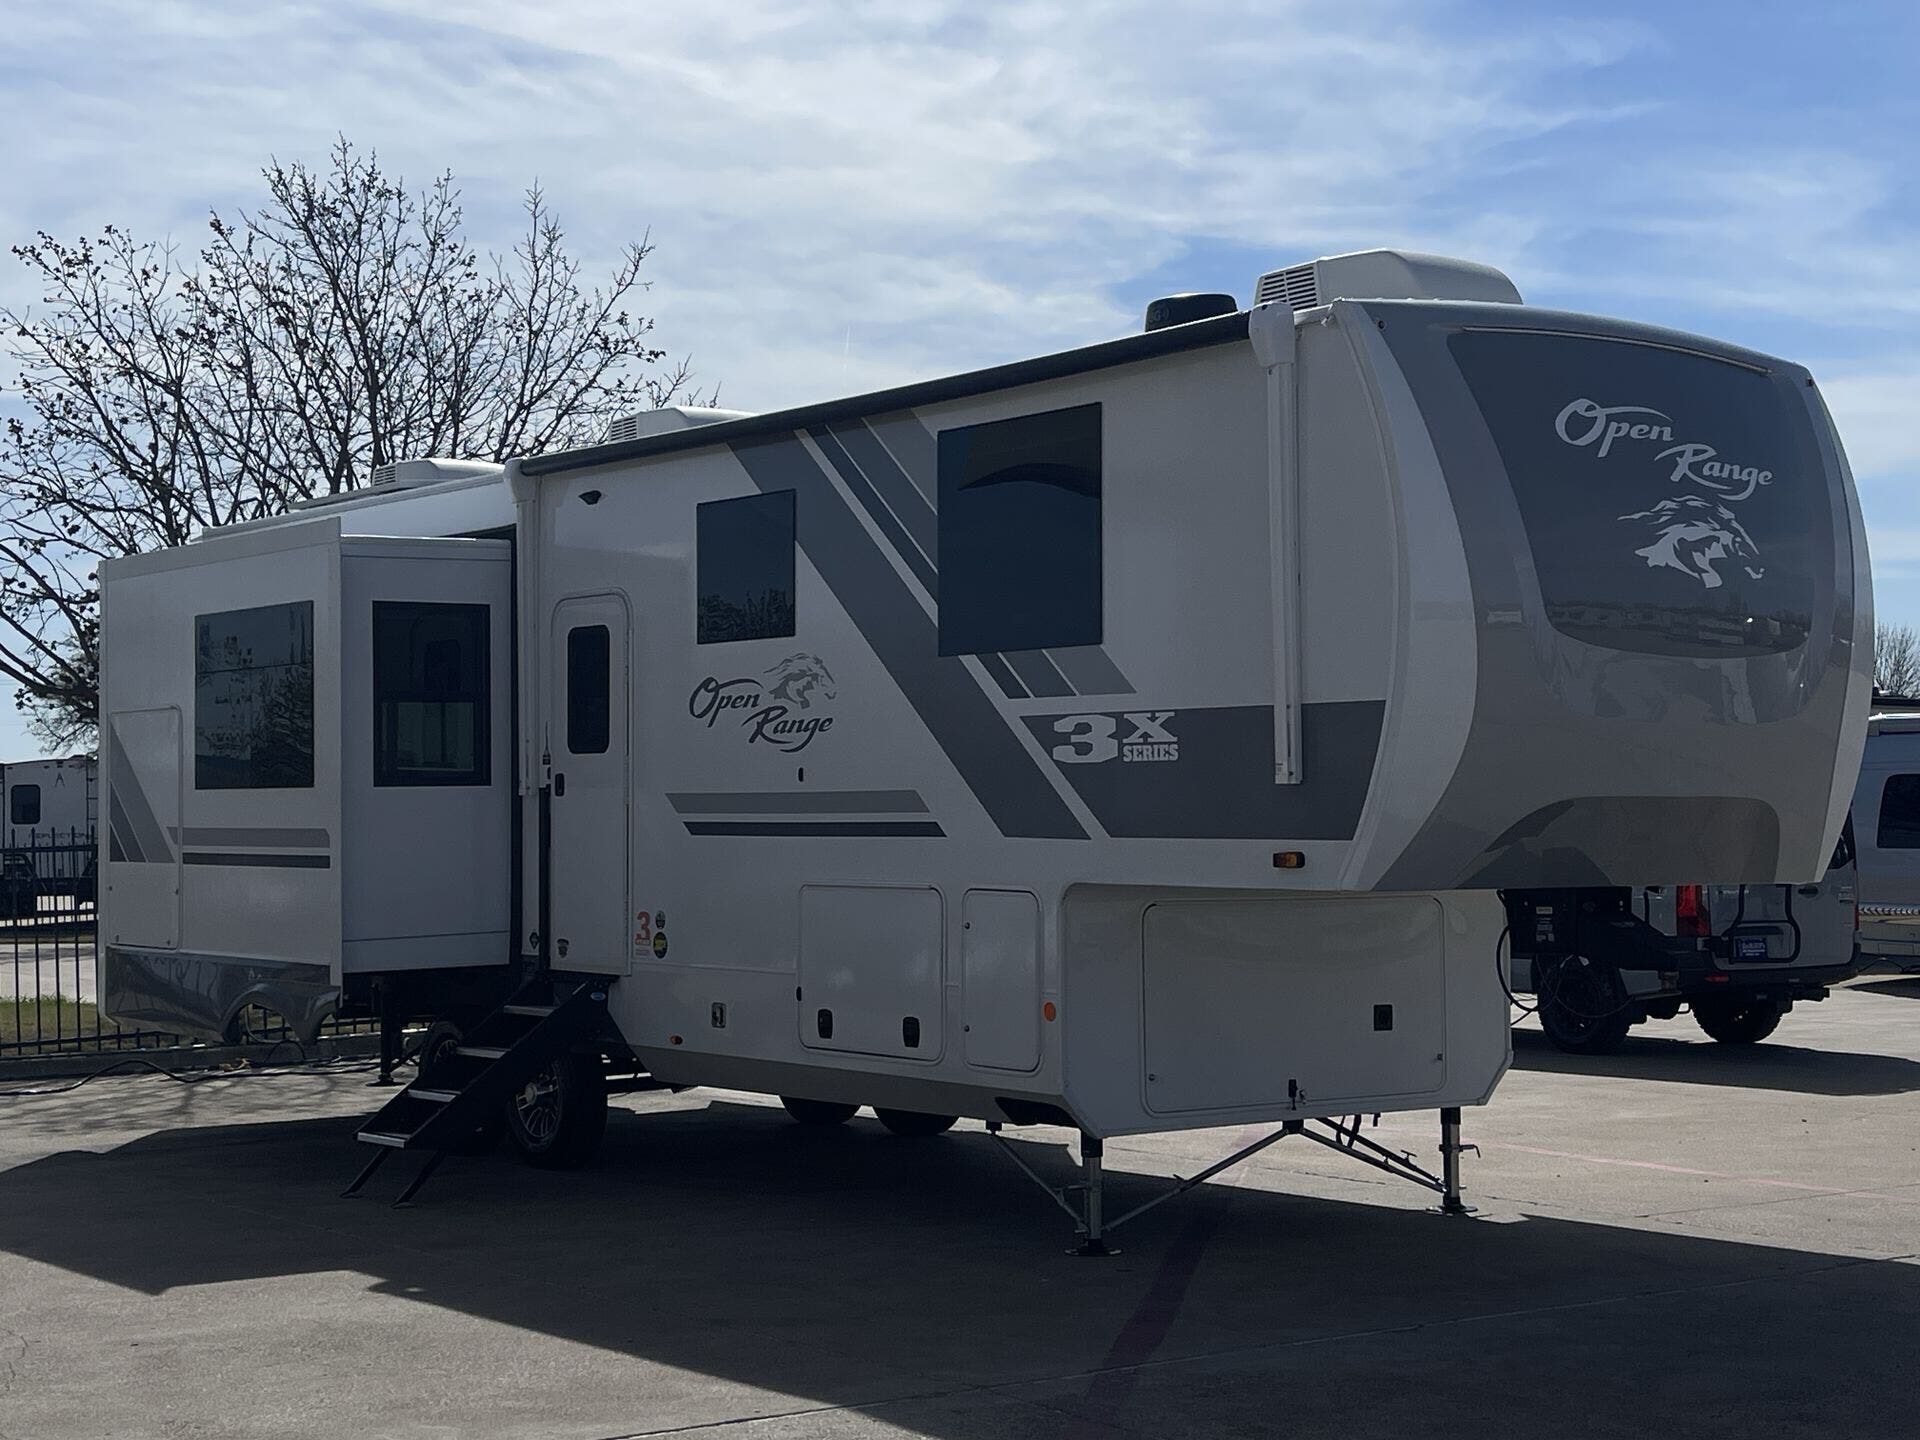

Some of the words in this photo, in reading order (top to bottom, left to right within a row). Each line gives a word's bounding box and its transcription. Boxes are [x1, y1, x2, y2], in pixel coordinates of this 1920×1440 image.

[1555, 398, 1674, 458] Open
[1654, 443, 1774, 501] Range
[689, 676, 764, 728] Open
[741, 705, 834, 753] Range
[1122, 743, 1179, 763] SERIES
[636, 911, 651, 939] 3
